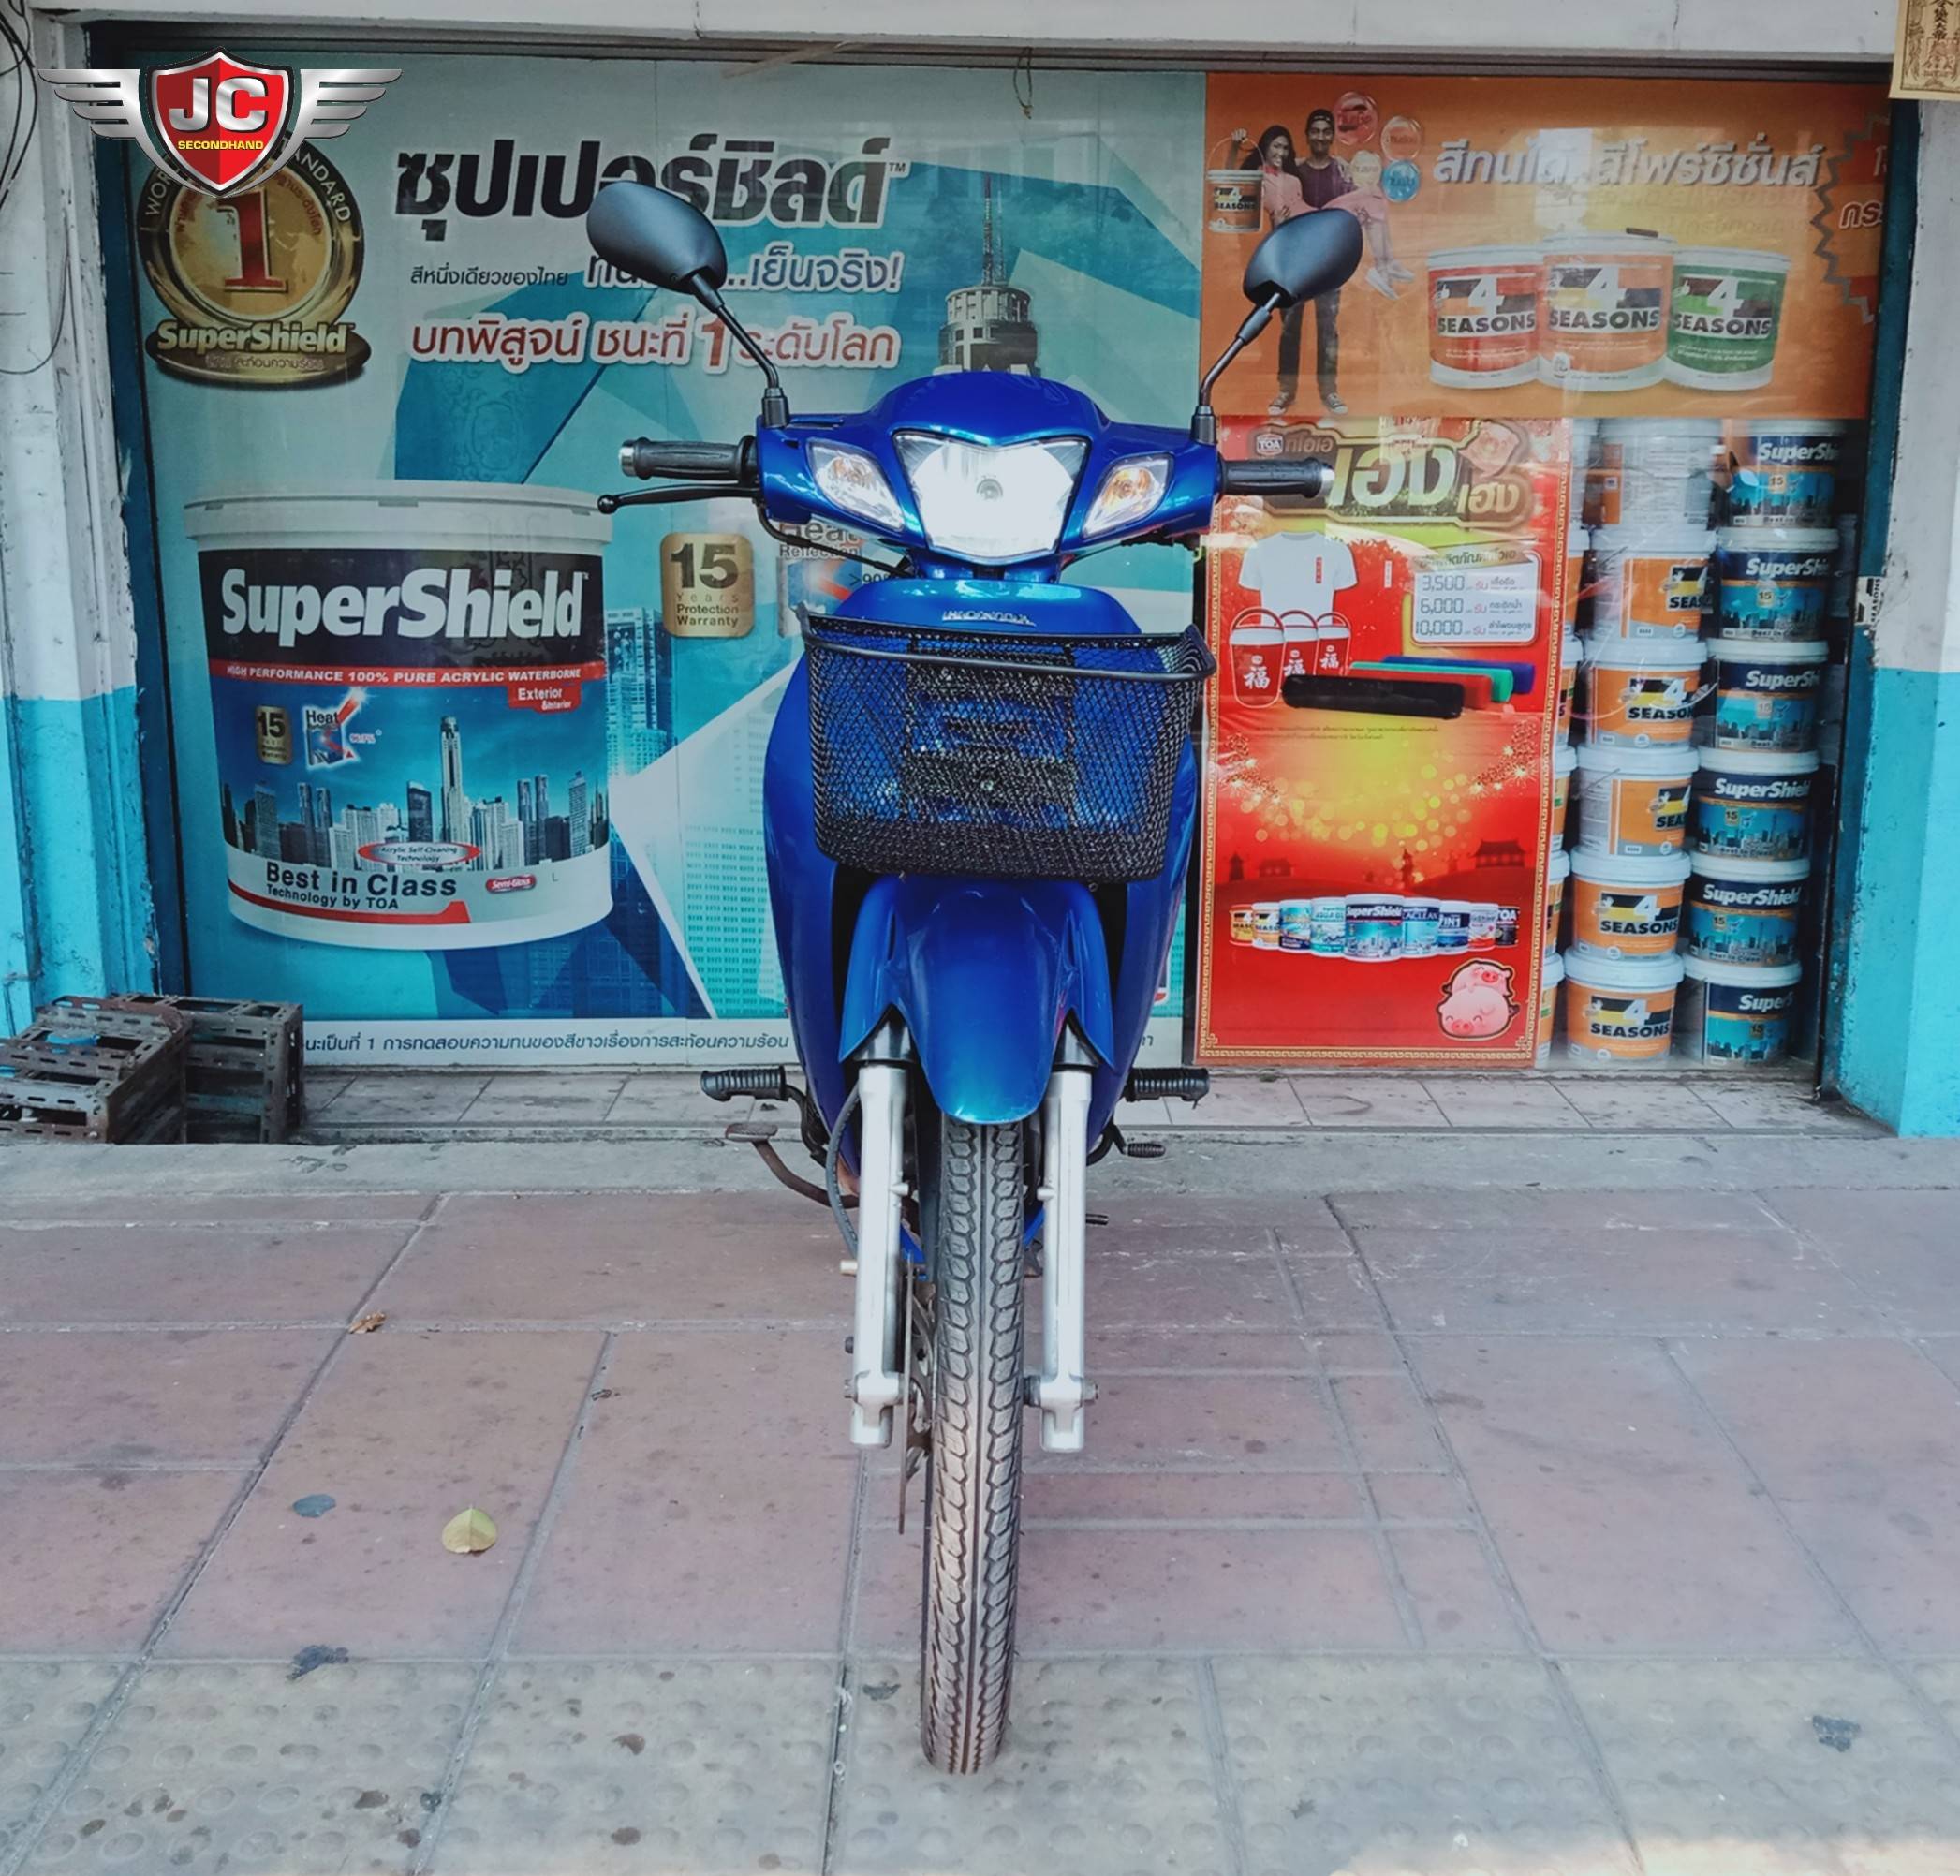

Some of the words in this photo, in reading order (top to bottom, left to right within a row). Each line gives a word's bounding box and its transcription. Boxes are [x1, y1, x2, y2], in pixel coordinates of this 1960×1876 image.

[218, 187, 287, 294] 1
[410, 262, 568, 286] สีหนึ่งเดียวของไทย
[1468, 276, 1506, 315] 4
[1587, 267, 1628, 309] 4
[1706, 277, 1745, 315] 4
[1437, 314, 1536, 334] SEASONS
[1549, 308, 1660, 330] SEASONS
[1672, 313, 1772, 335] SEASONS
[156, 320, 348, 354] SuperShield
[412, 319, 582, 366] บทพิสูจน์
[597, 312, 688, 357] ชนะที่
[701, 317, 726, 367] 1
[739, 319, 894, 362] ระดับโลก
[1259, 440, 1282, 449] TOA
[779, 543, 860, 558] Reflecon
[671, 543, 739, 589] 15
[1422, 575, 1466, 591] 3,500
[677, 593, 739, 602] Years
[1758, 591, 1772, 600] 15
[221, 567, 582, 647] SuperShield
[677, 604, 739, 614] Protection
[1420, 598, 1464, 614] 6,000
[677, 616, 739, 628] Warranty
[1416, 619, 1463, 636] 10,000
[227, 665, 247, 677] HIGH
[249, 666, 344, 682] PERFORMANCE
[347, 671, 390, 683] 100%
[393, 672, 436, 683] PURE
[439, 671, 504, 683] ACRYLIC
[508, 668, 581, 682] WATERBORNE
[1243, 665, 1271, 689] 福
[518, 687, 563, 701] Exterior
[1663, 678, 1687, 706] 4
[257, 711, 286, 737] 15
[305, 709, 338, 725] Heat
[1725, 811, 1738, 820] 15
[267, 861, 320, 890] Best
[332, 871, 358, 894] in
[367, 873, 457, 896] Class
[492, 877, 532, 890] Semi-Gloss
[267, 883, 337, 908] Technology
[343, 893, 361, 910] by
[366, 897, 398, 909] TOA
[1634, 894, 1658, 922] 4
[1600, 918, 1678, 935] SEASONS
[1714, 916, 1726, 925] 15
[1623, 999, 1647, 1026] 4
[1590, 1022, 1671, 1039] SEASONS
[367, 1037, 374, 1050] 1
